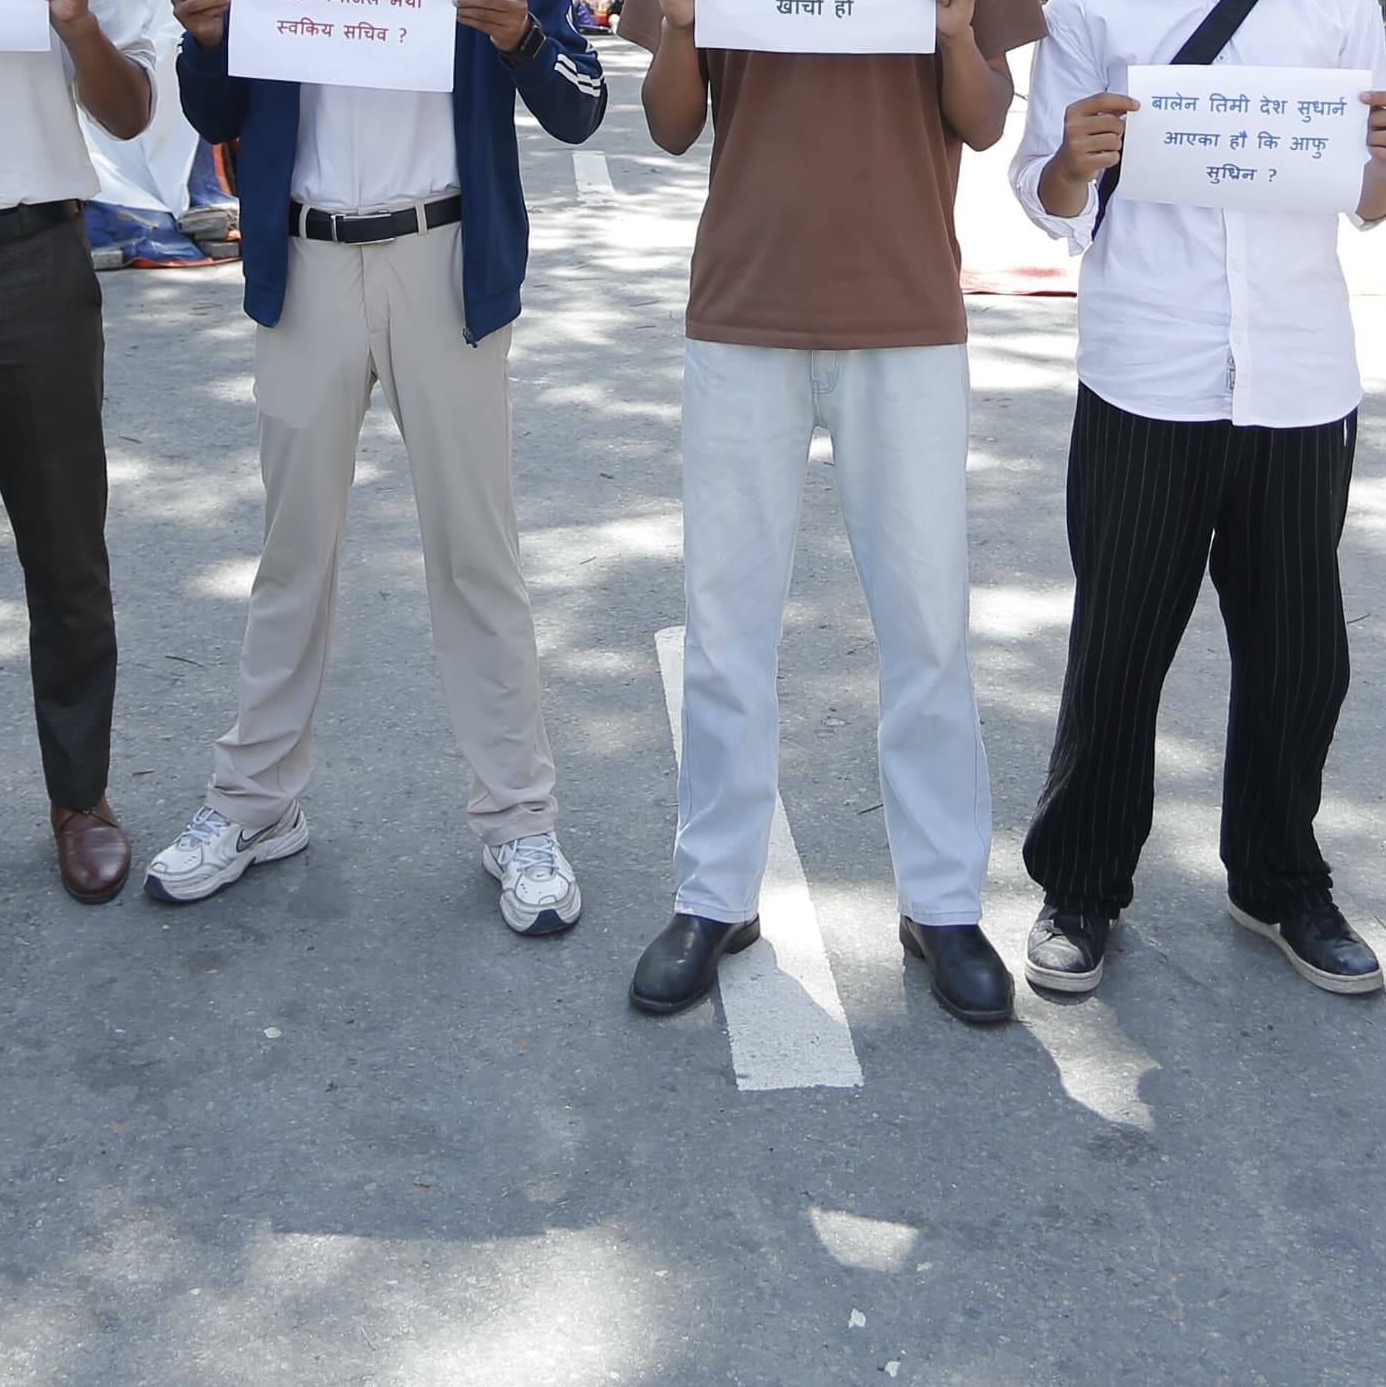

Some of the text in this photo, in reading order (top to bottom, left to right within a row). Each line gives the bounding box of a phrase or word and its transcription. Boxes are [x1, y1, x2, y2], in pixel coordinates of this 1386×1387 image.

[277, 17, 407, 43] स्वकिय सचिव ?
[1151, 92, 1347, 123] बालेन तिमी देश सुधार्न
[1163, 132, 1221, 147] आएका
[1257, 131, 1281, 149] कि
[1290, 137, 1329, 159] आफु
[1269, 169, 1277, 182] ?
